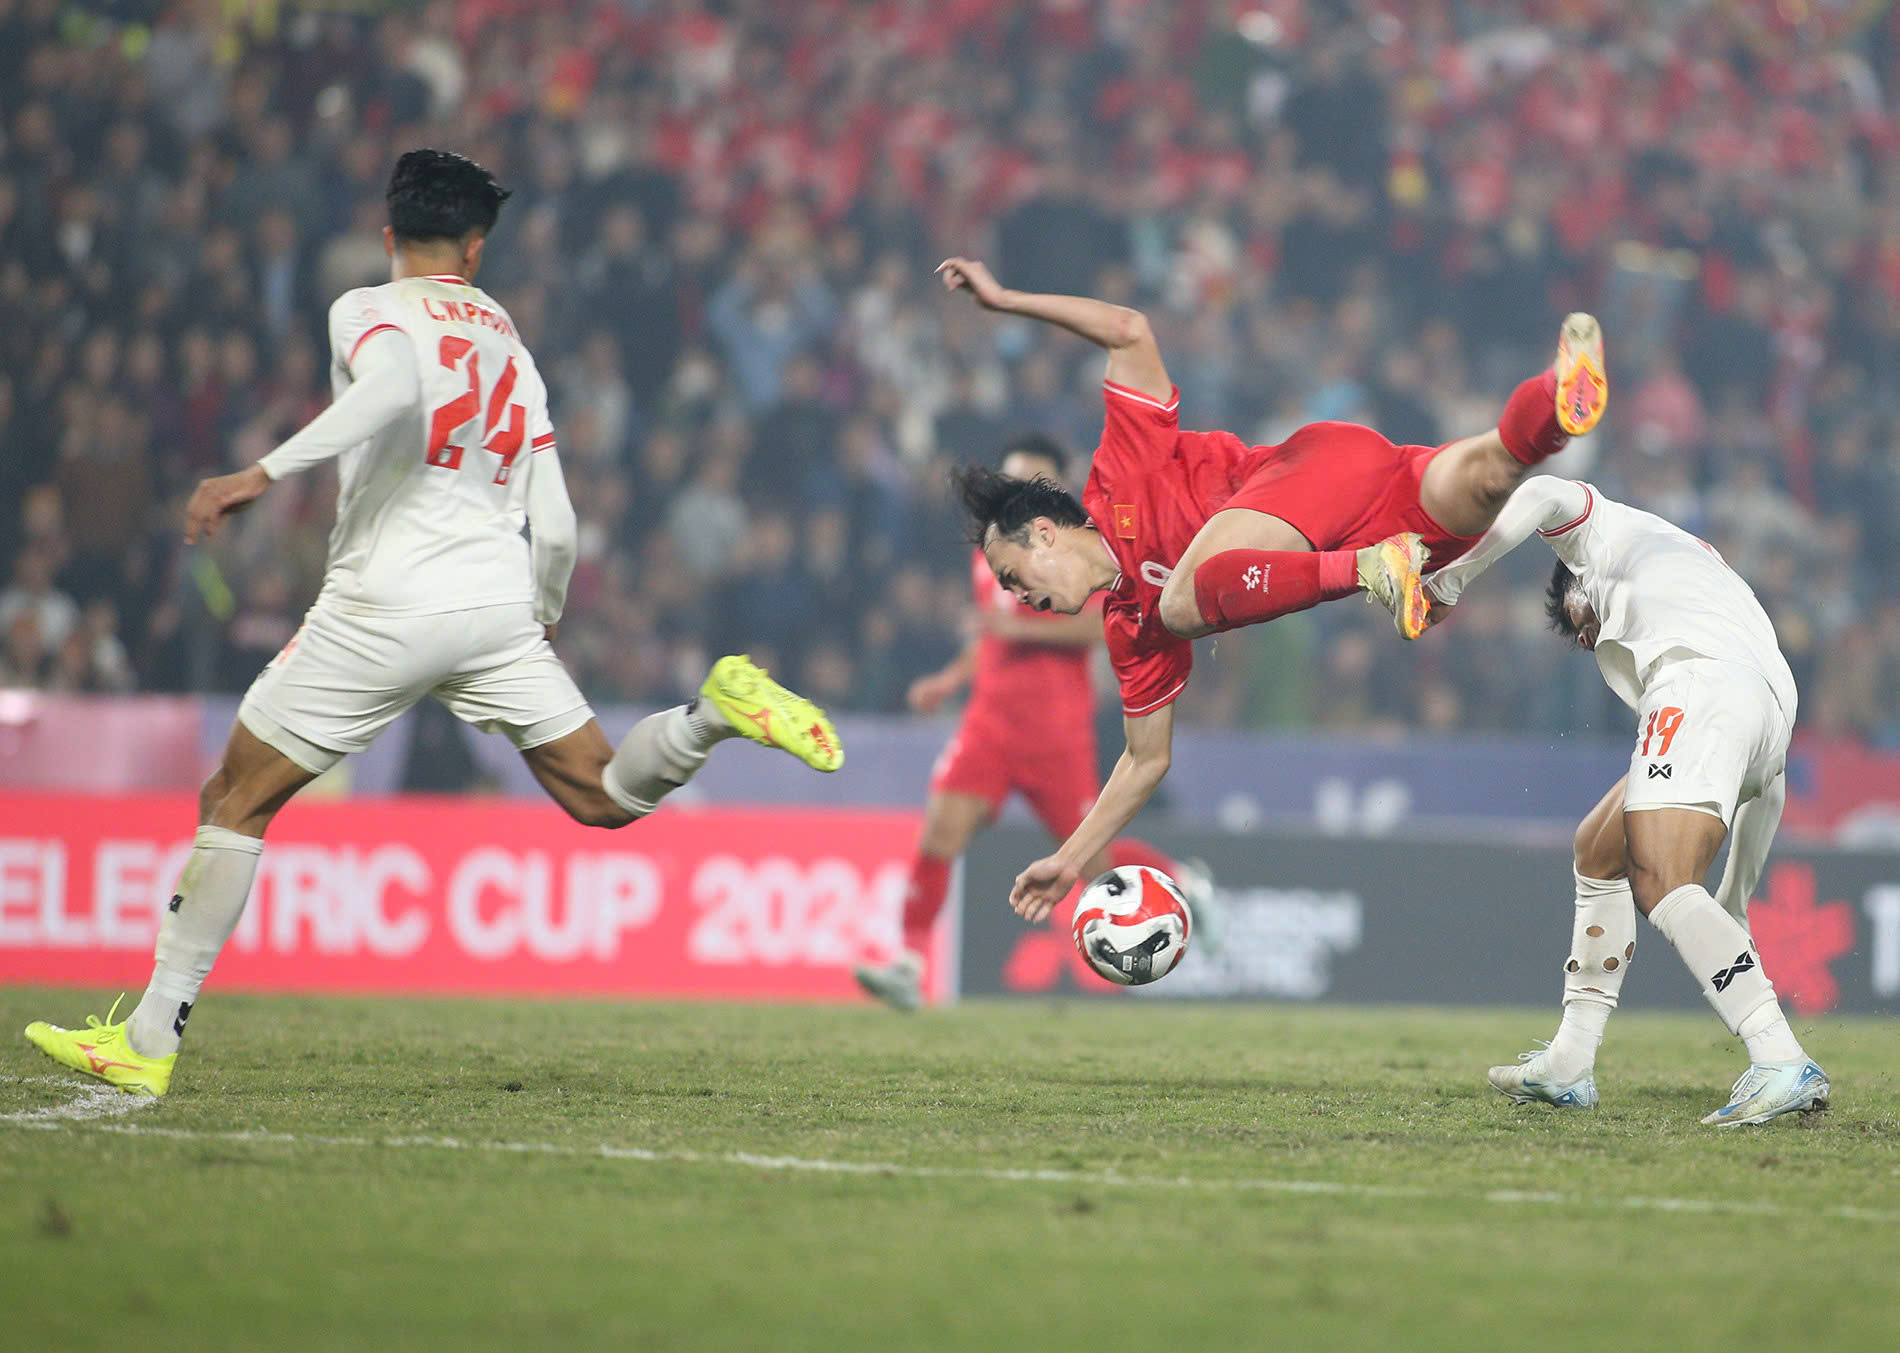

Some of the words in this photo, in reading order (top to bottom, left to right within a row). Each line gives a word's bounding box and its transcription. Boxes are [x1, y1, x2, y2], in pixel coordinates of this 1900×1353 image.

[425, 334, 527, 486] 24
[1641, 706, 1685, 757] 19
[445, 844, 664, 961] CUP
